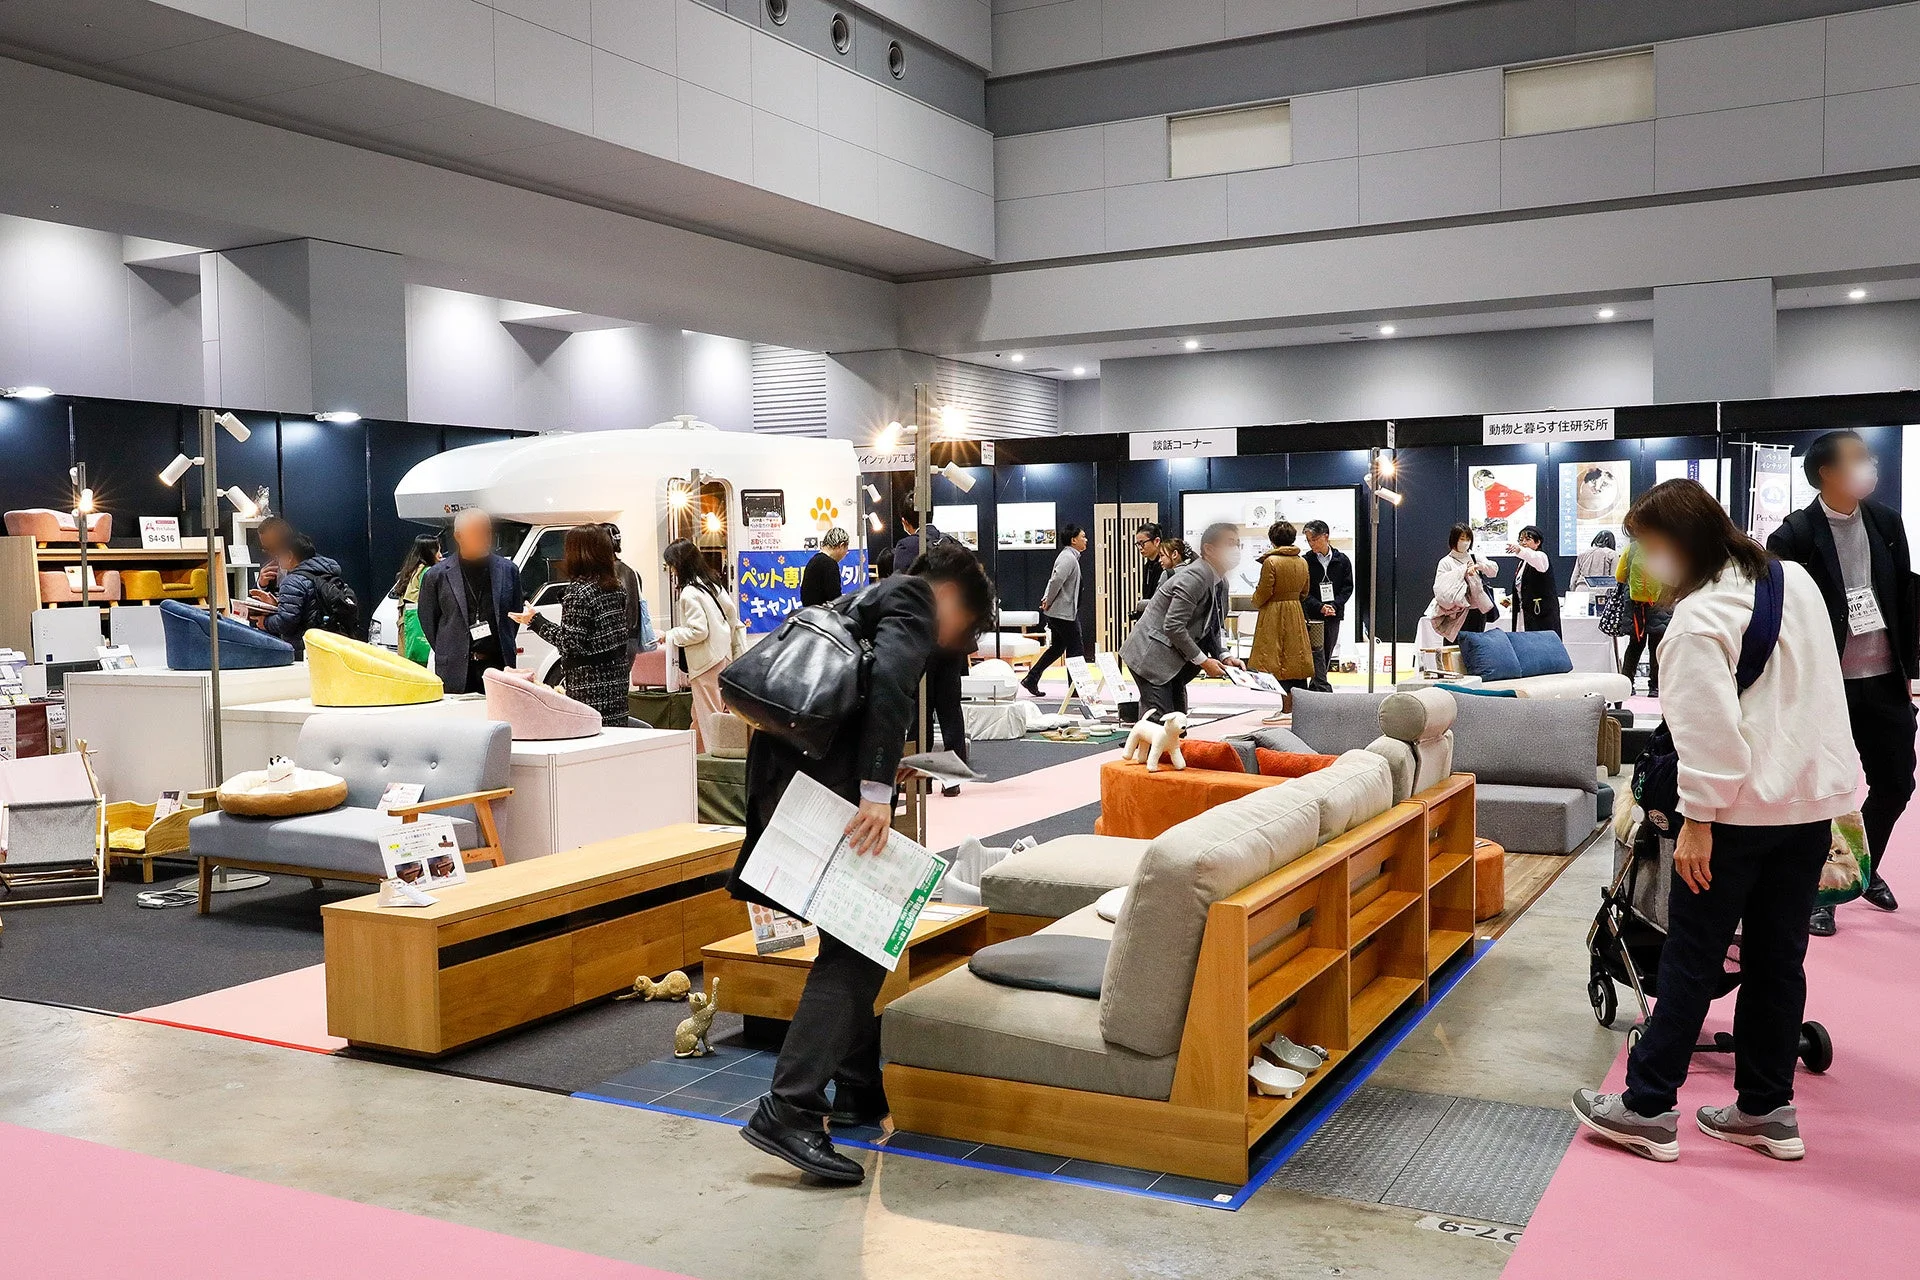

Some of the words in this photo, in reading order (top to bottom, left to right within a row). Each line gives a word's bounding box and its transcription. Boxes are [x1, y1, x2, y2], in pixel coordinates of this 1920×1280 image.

[1488, 418, 1609, 436] 動物と暮らす住研究所
[1152, 438, 1213, 451] 談話コーナー
[1849, 602, 1863, 613] VIP
